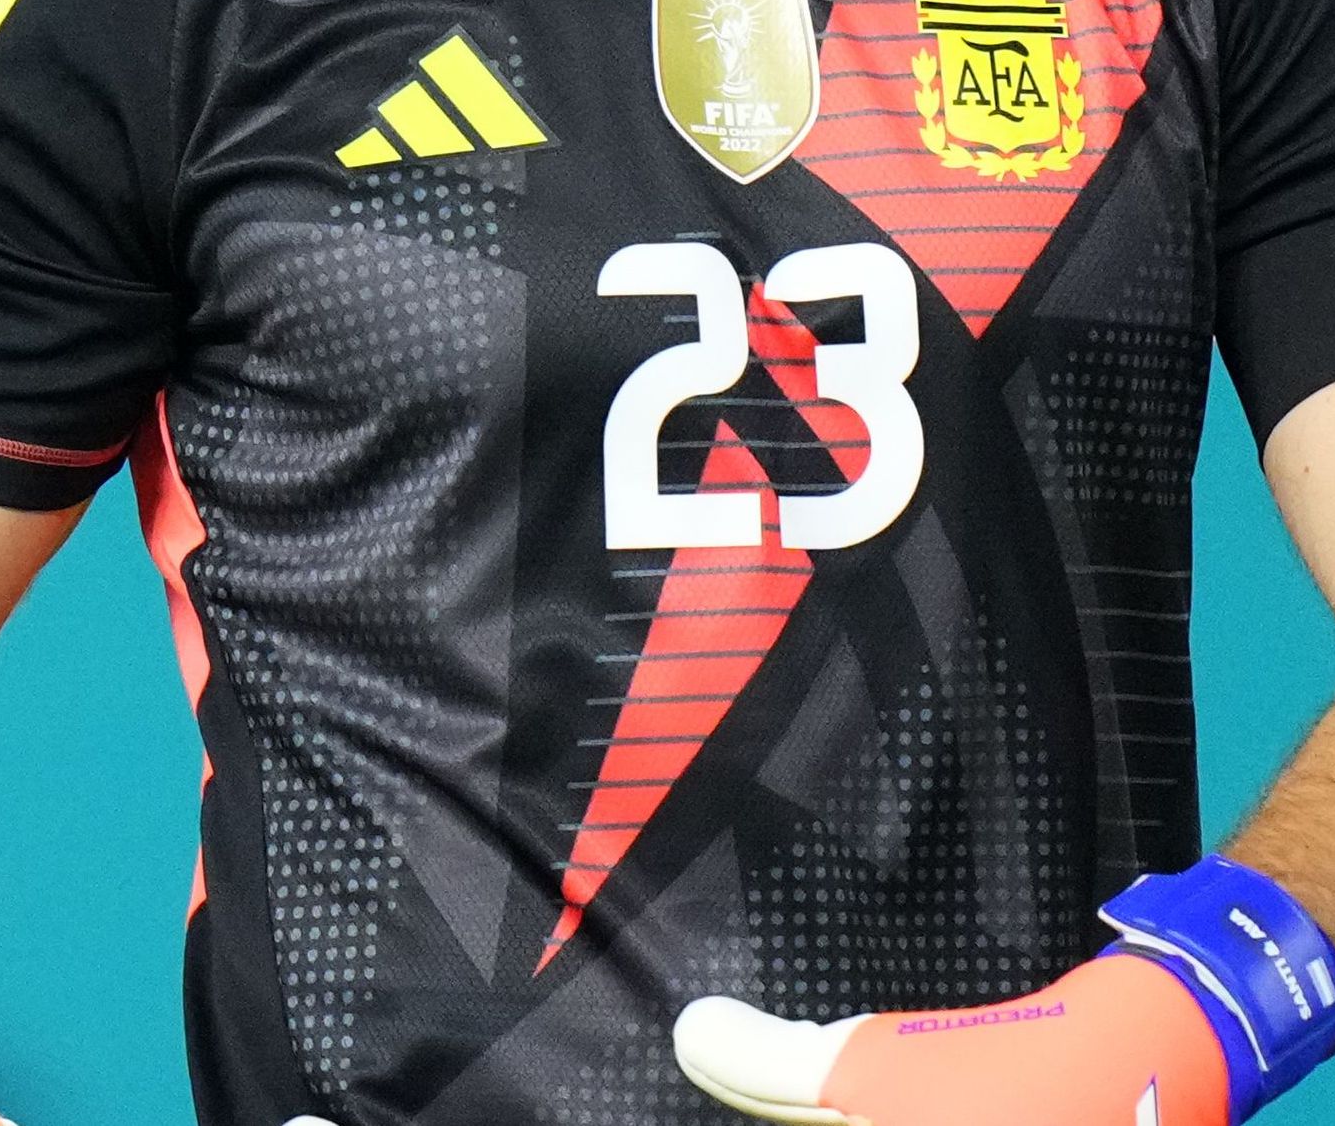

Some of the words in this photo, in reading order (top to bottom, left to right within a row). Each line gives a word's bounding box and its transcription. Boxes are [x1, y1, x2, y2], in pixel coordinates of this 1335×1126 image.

[953, 37, 1049, 122] AFA
[704, 102, 775, 126] FIFA
[690, 125, 727, 136] WORLD
[719, 137, 762, 151] 2022
[597, 242, 924, 550] 23
[1229, 908, 1266, 939] AVA
[1274, 957, 1312, 1020] SANTI
[898, 1002, 1064, 1034] PREDATOR
